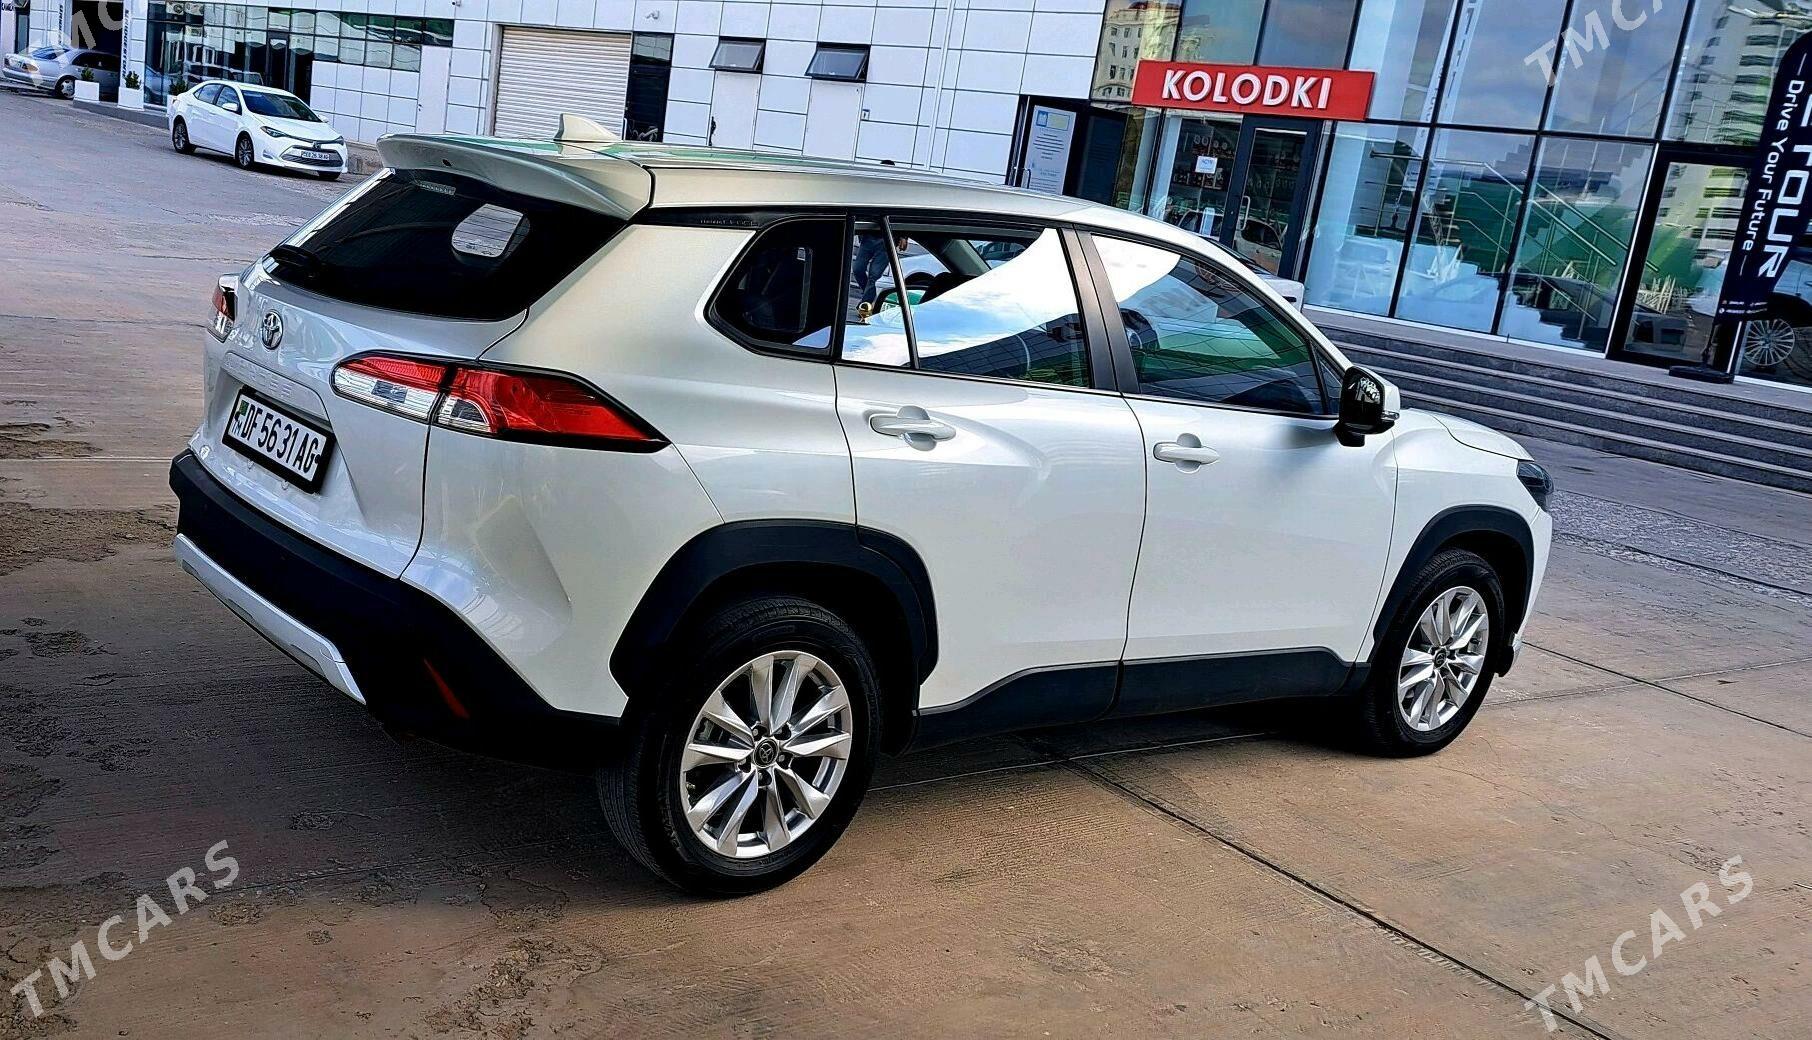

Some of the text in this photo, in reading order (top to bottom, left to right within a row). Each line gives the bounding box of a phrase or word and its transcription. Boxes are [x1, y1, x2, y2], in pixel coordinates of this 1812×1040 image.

[1161, 69, 1332, 109] KOLODKI
[1742, 79, 1805, 251] Drive Your Future
[241, 403, 263, 440] DF
[292, 433, 319, 473] AG
